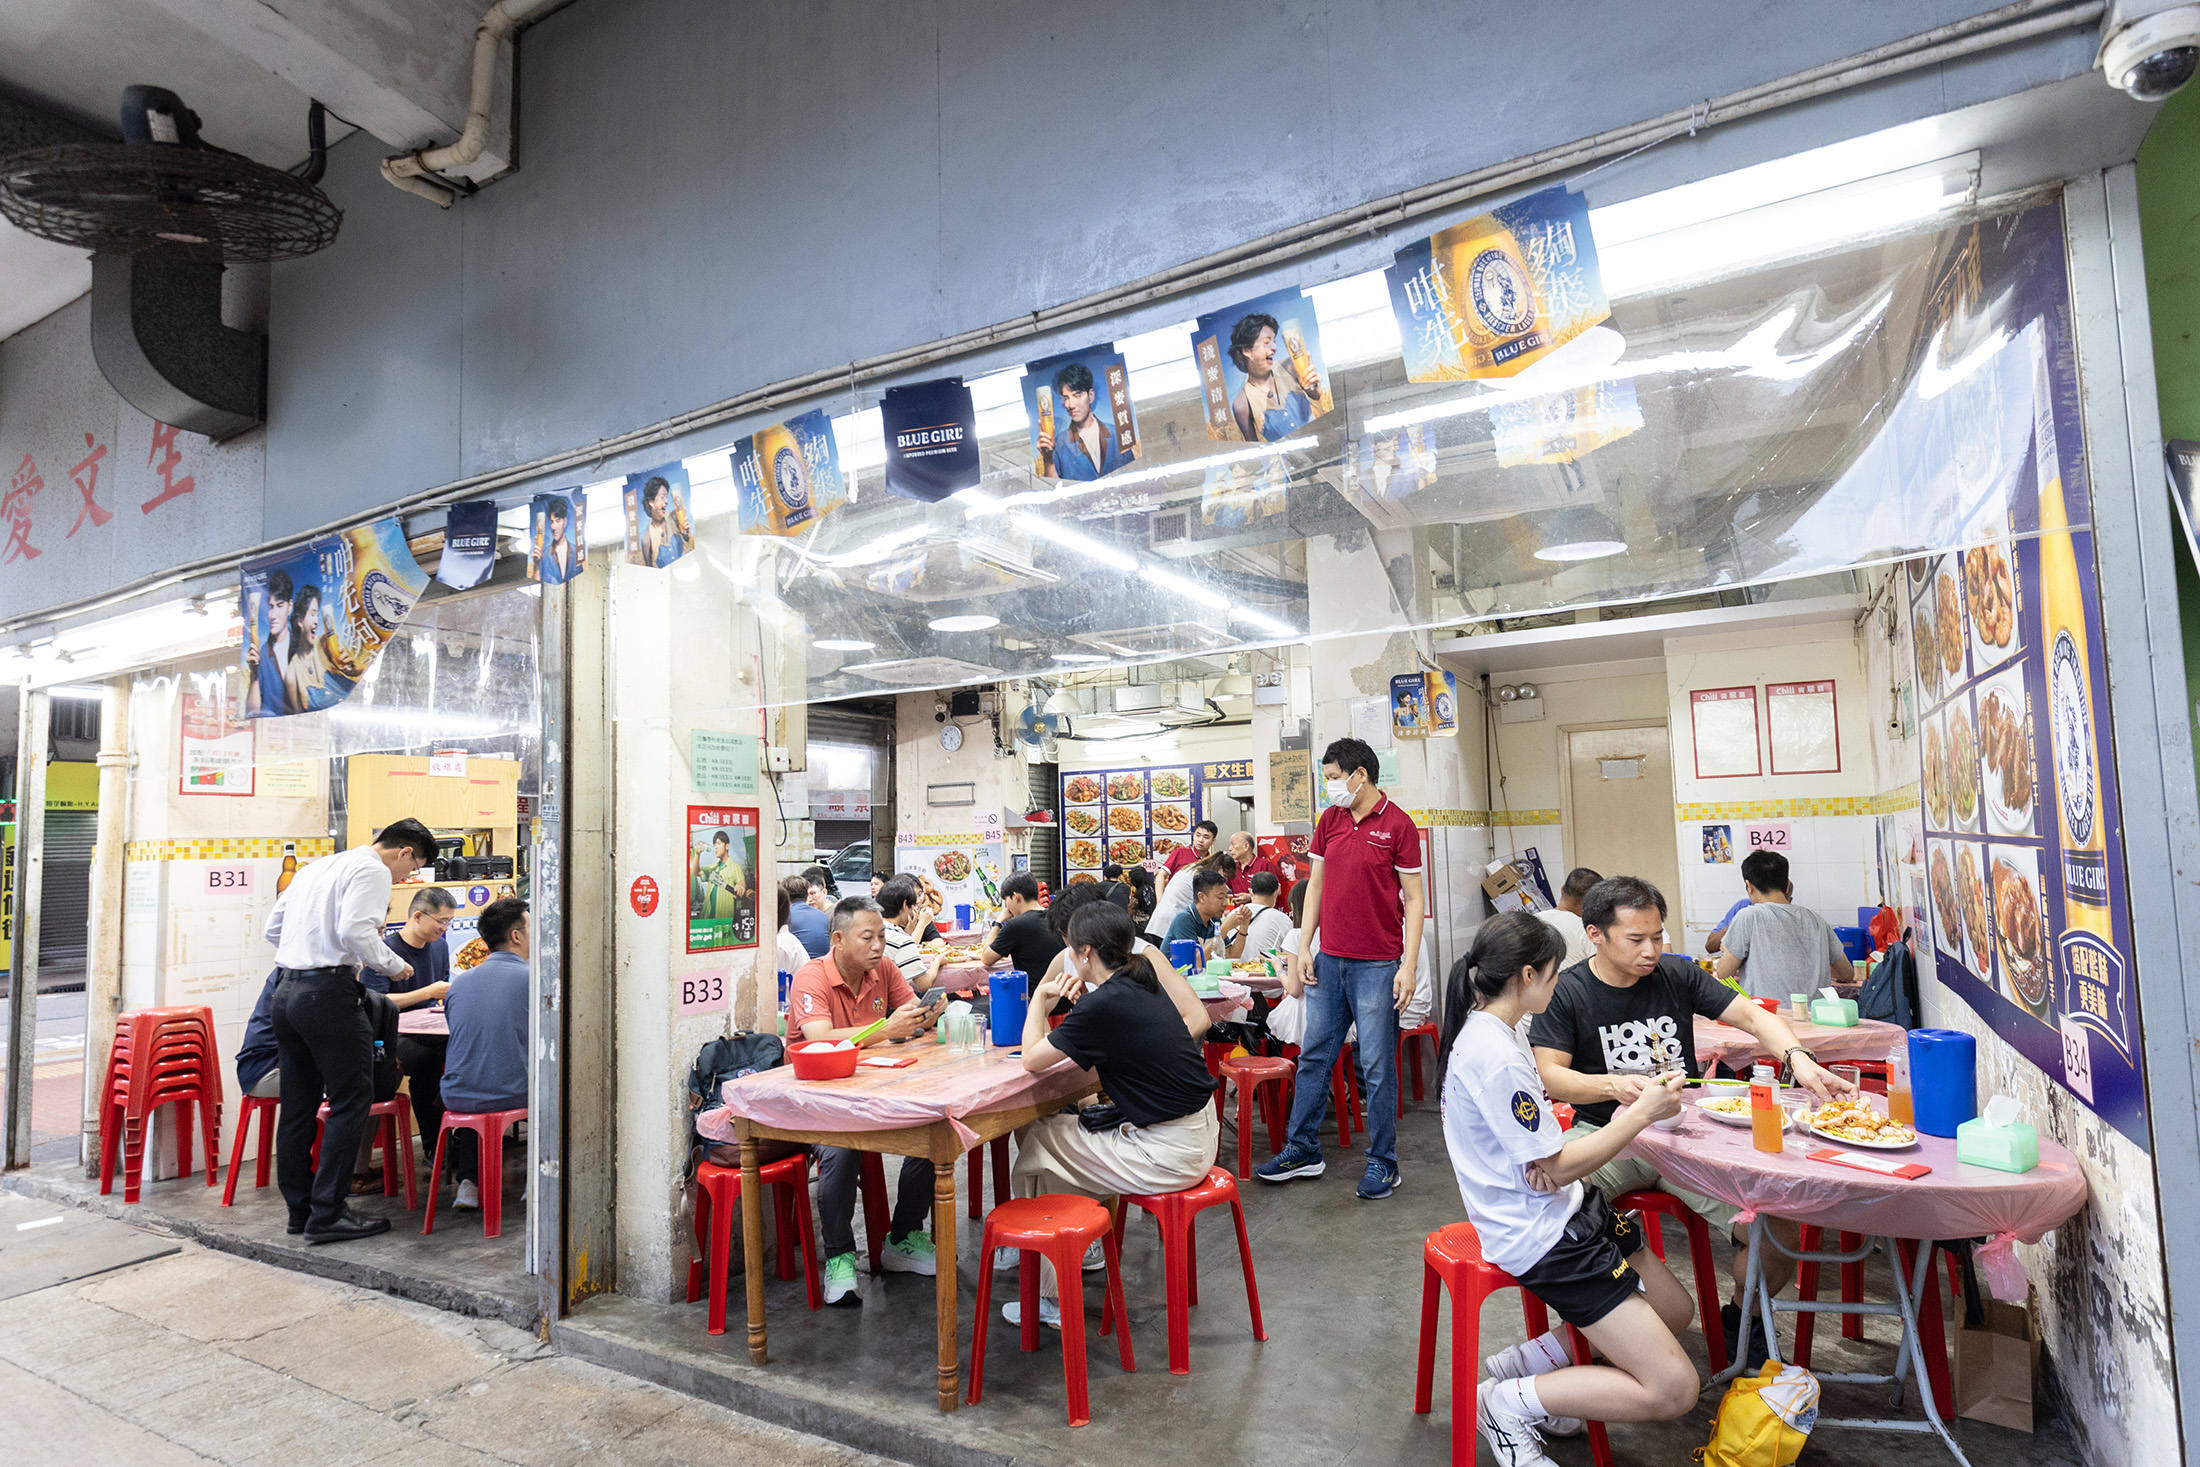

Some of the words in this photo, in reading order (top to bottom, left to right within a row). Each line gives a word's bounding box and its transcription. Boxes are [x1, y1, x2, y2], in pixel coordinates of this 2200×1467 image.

[1494, 341, 1528, 362] BLUE
[1109, 369, 1133, 447] 深麥質感
[897, 432, 931, 448] BLUE
[930, 427, 963, 443] GIRL
[452, 538, 471, 548] BLUE
[471, 536, 490, 547] GIRL
[1699, 692, 1718, 702] Chill
[1776, 686, 1795, 695] Chill
[698, 811, 720, 824] Chill
[898, 834, 914, 843] B43
[985, 830, 1001, 841] B45
[1750, 830, 1787, 846] B42
[1142, 861, 1157, 870] B49
[209, 871, 249, 888] B31
[2064, 863, 2085, 888] BLUE
[2084, 866, 2106, 890] GIRL
[682, 979, 724, 1006] B33
[802, 993, 813, 1014] 3
[1598, 1015, 1678, 1048] HONG
[1602, 1037, 1683, 1071] KONG
[2064, 1033, 2088, 1084] B34
